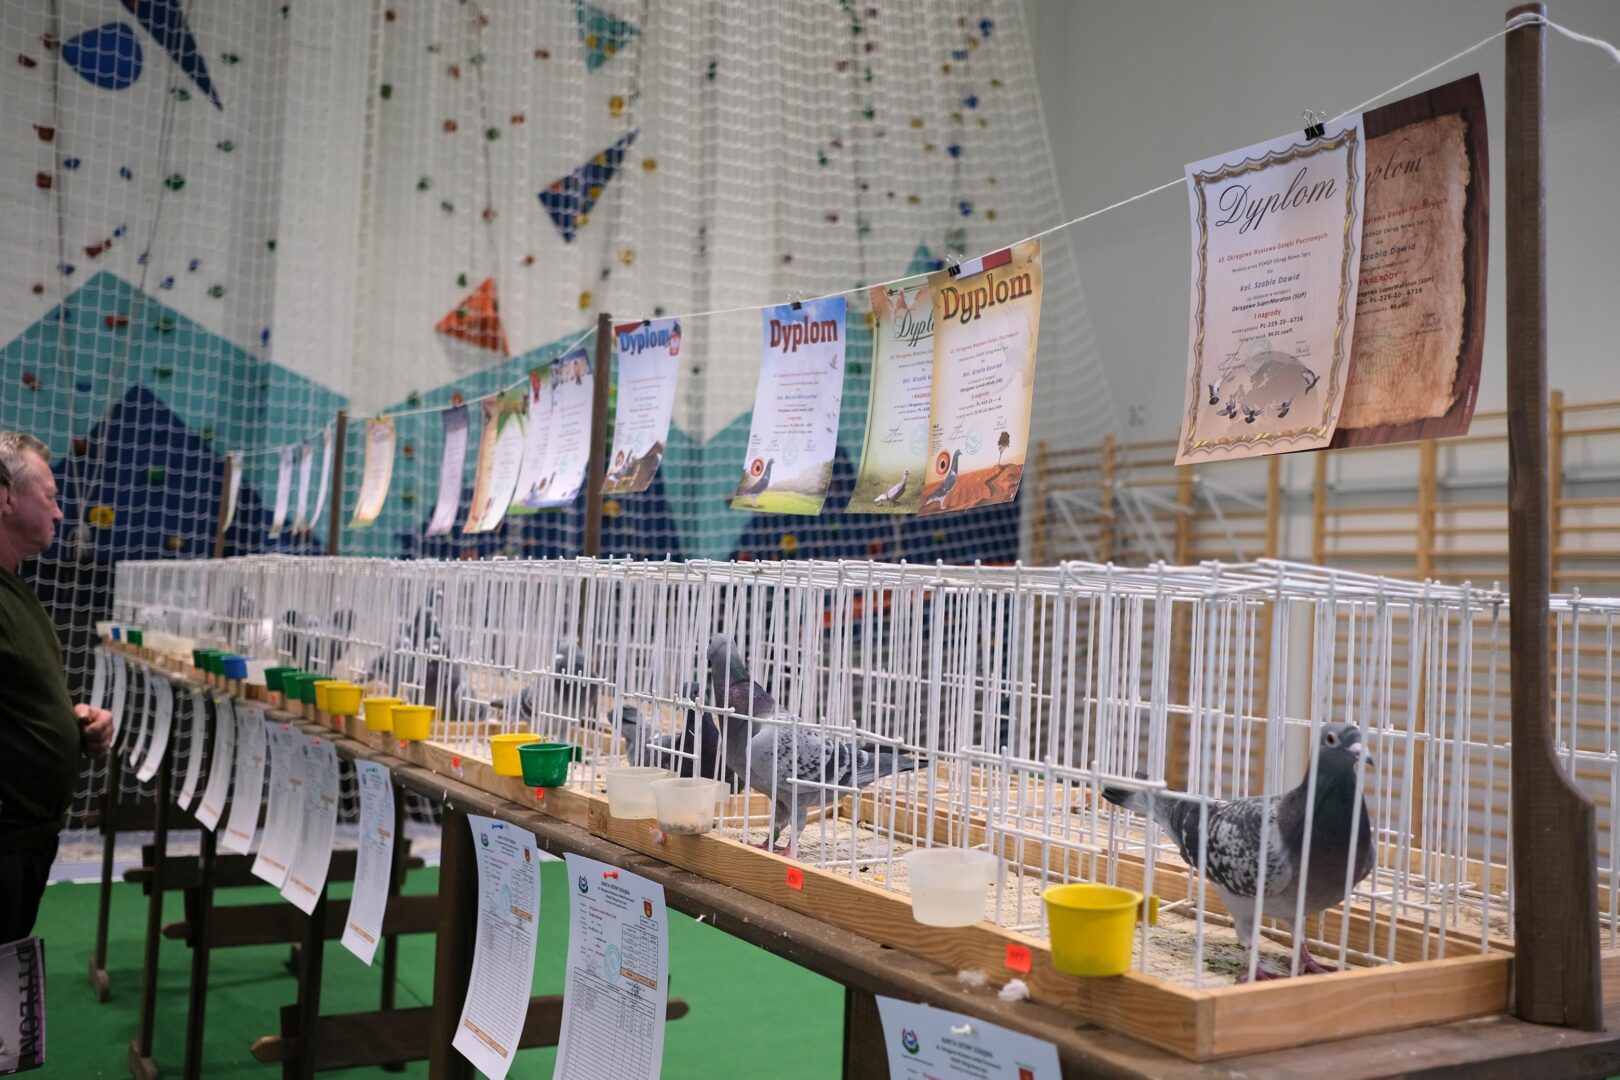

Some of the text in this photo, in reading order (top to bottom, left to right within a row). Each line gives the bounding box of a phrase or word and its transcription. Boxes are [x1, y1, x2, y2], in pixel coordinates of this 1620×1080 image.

[1364, 138, 1422, 199] yplom
[1215, 167, 1337, 234] Dyplom
[1390, 243, 1416, 255] Dawid
[1278, 272, 1301, 284] Dawid
[1363, 271, 1399, 286] NAGRODY
[941, 273, 1032, 324] Dyplom
[1257, 308, 1282, 319] nagrody
[620, 328, 670, 355] Dyplom
[770, 316, 838, 353] Dyplom
[893, 308, 934, 347] Dypl
